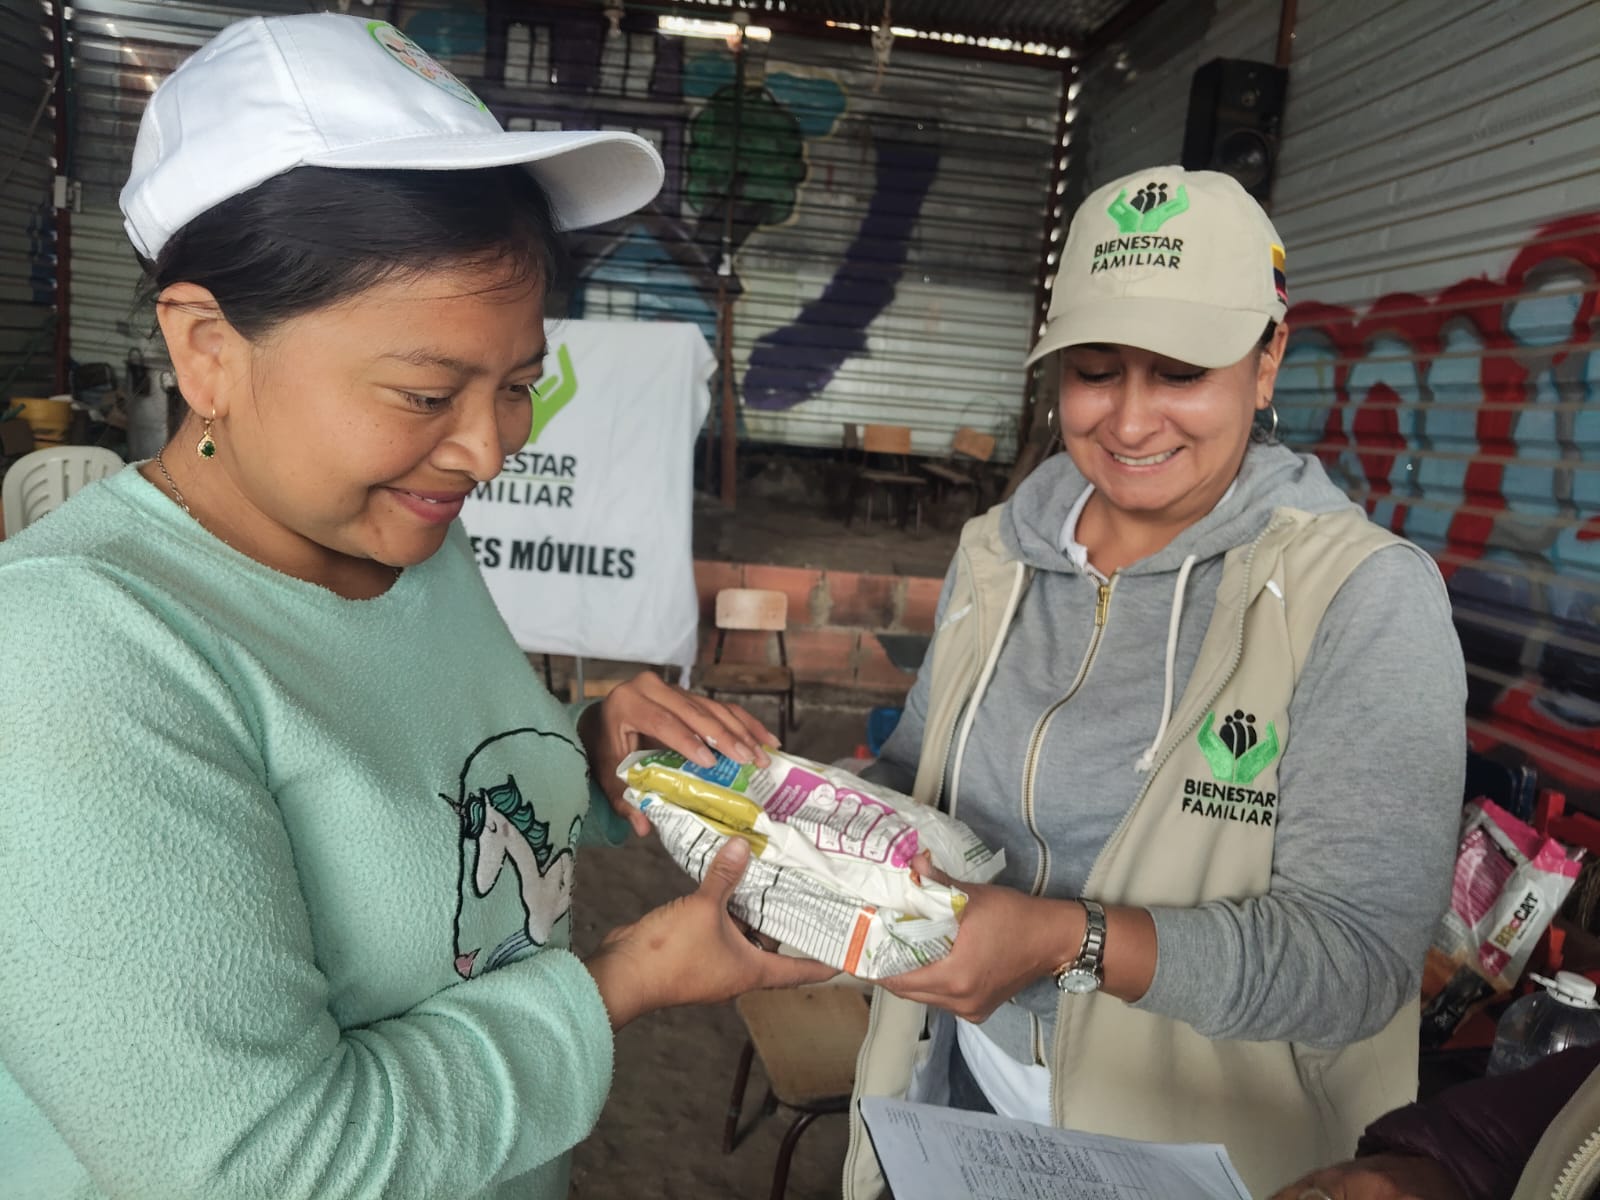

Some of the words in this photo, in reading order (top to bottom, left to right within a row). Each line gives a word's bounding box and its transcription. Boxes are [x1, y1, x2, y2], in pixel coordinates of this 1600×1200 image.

[1094, 235, 1184, 258] BIENESTAR
[1090, 253, 1181, 275] FAMILIAR
[502, 452, 576, 477] ESTAR
[467, 480, 573, 507] MILIAR
[510, 535, 635, 579] MÓVILES
[1184, 778, 1276, 807] BIENESTAR
[1182, 797, 1273, 826] FAMILIAR
